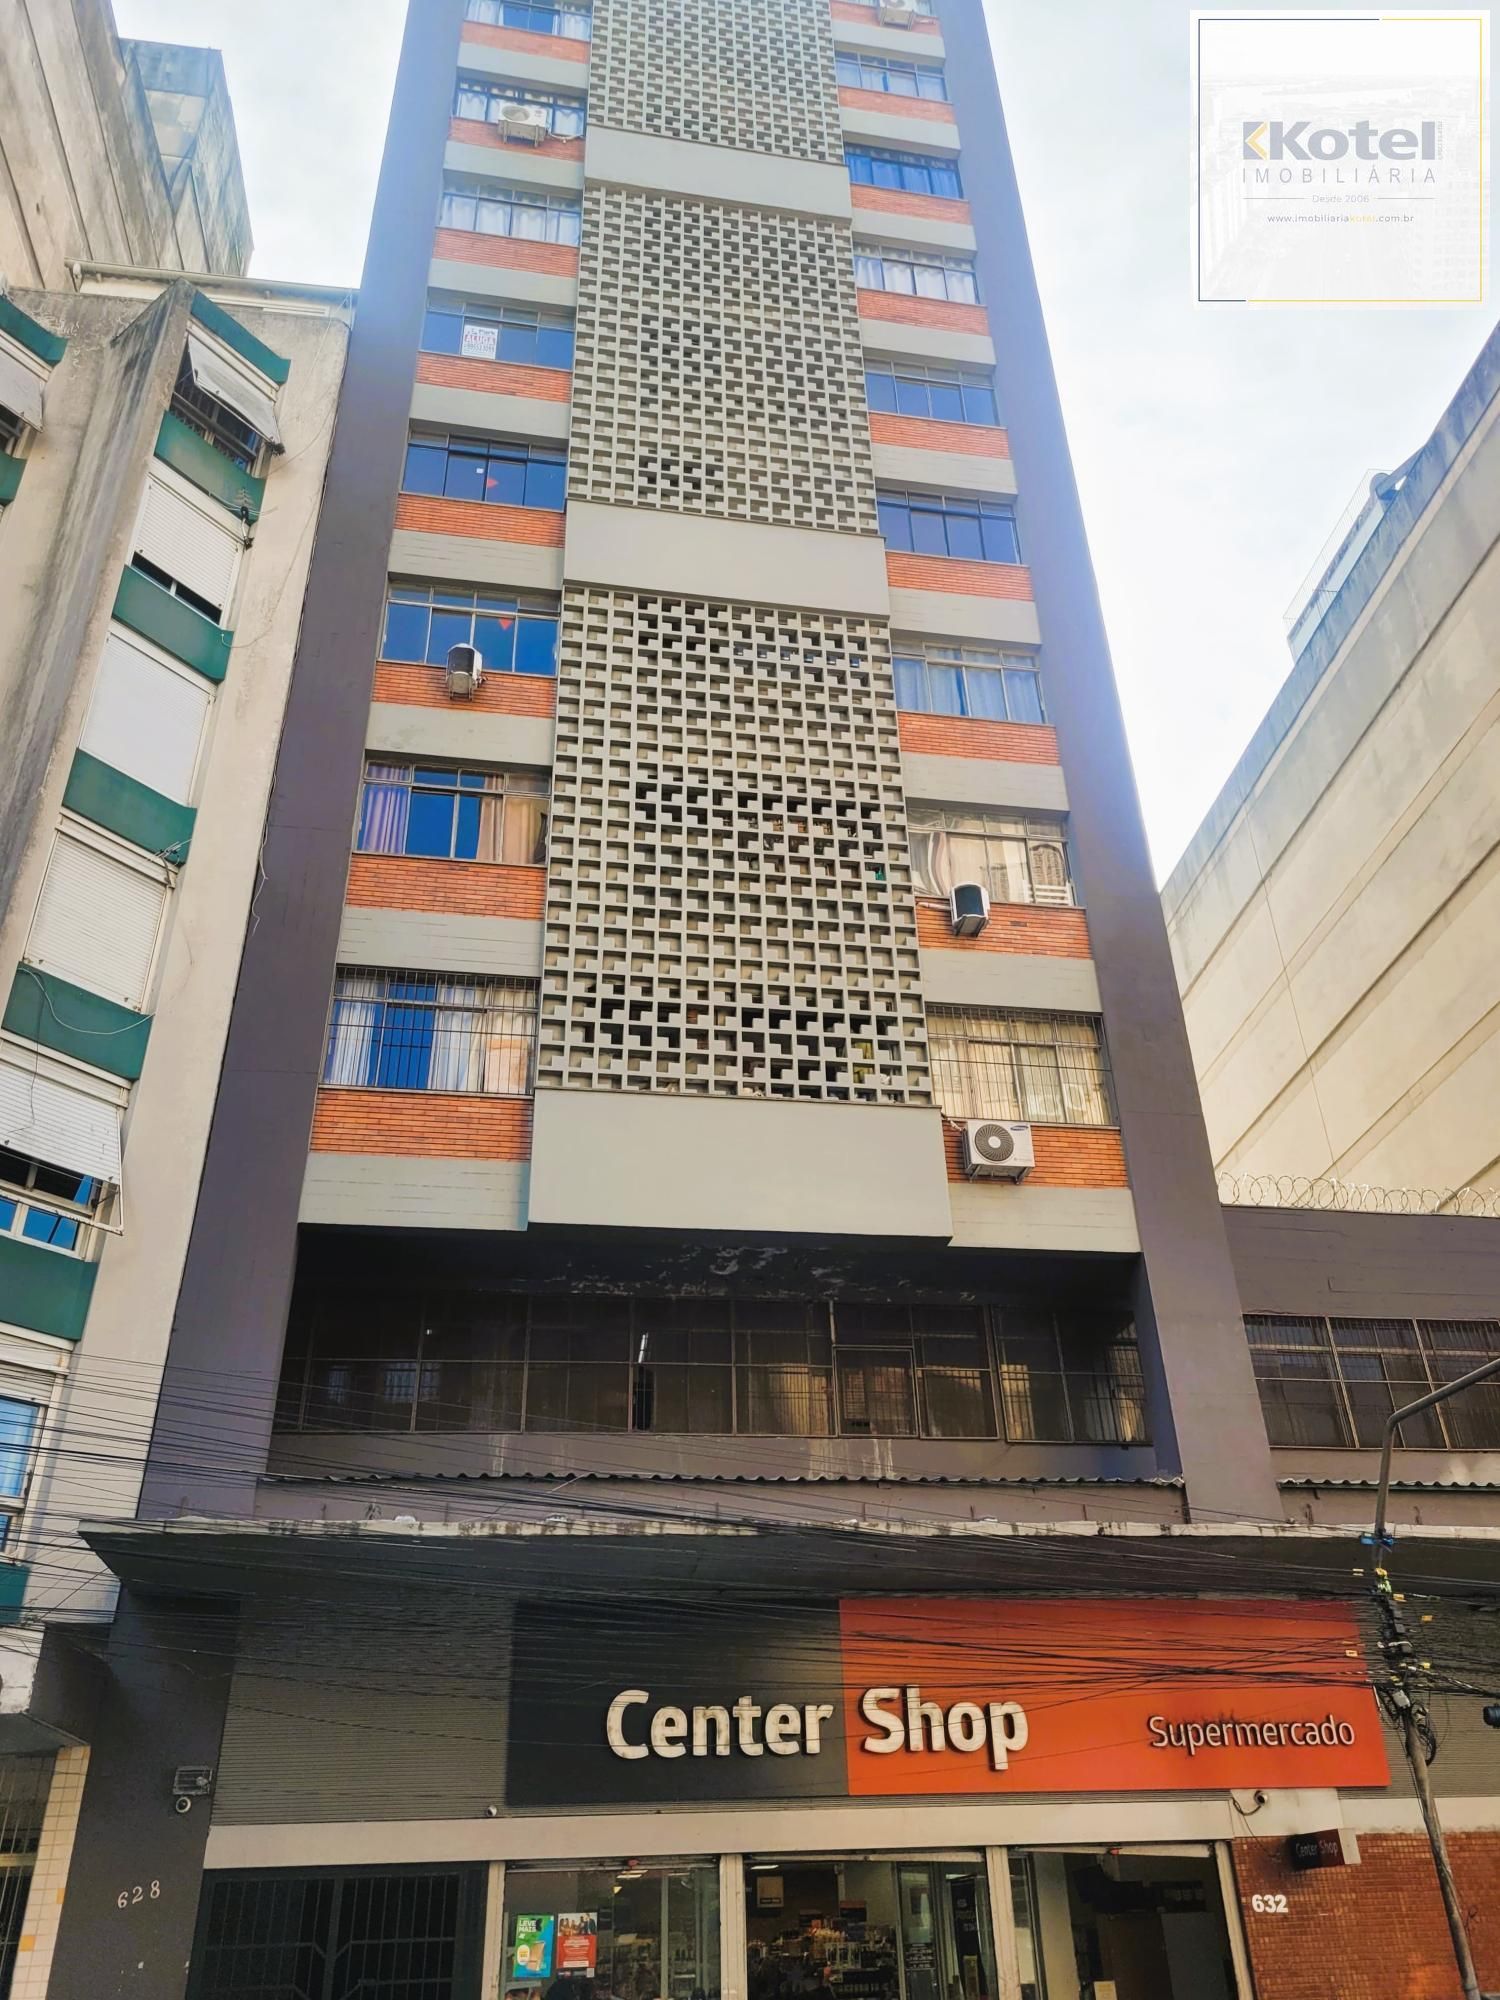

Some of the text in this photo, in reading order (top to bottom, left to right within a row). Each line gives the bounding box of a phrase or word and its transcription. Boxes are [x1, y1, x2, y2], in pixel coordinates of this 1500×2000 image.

[606, 1684, 1029, 1770] Center Shop
[1149, 1714, 1356, 1756] Supermercado
[1295, 1840, 1339, 1858] Center Shop
[117, 1879, 161, 1909] 628
[1251, 1893, 1289, 1914] 632
